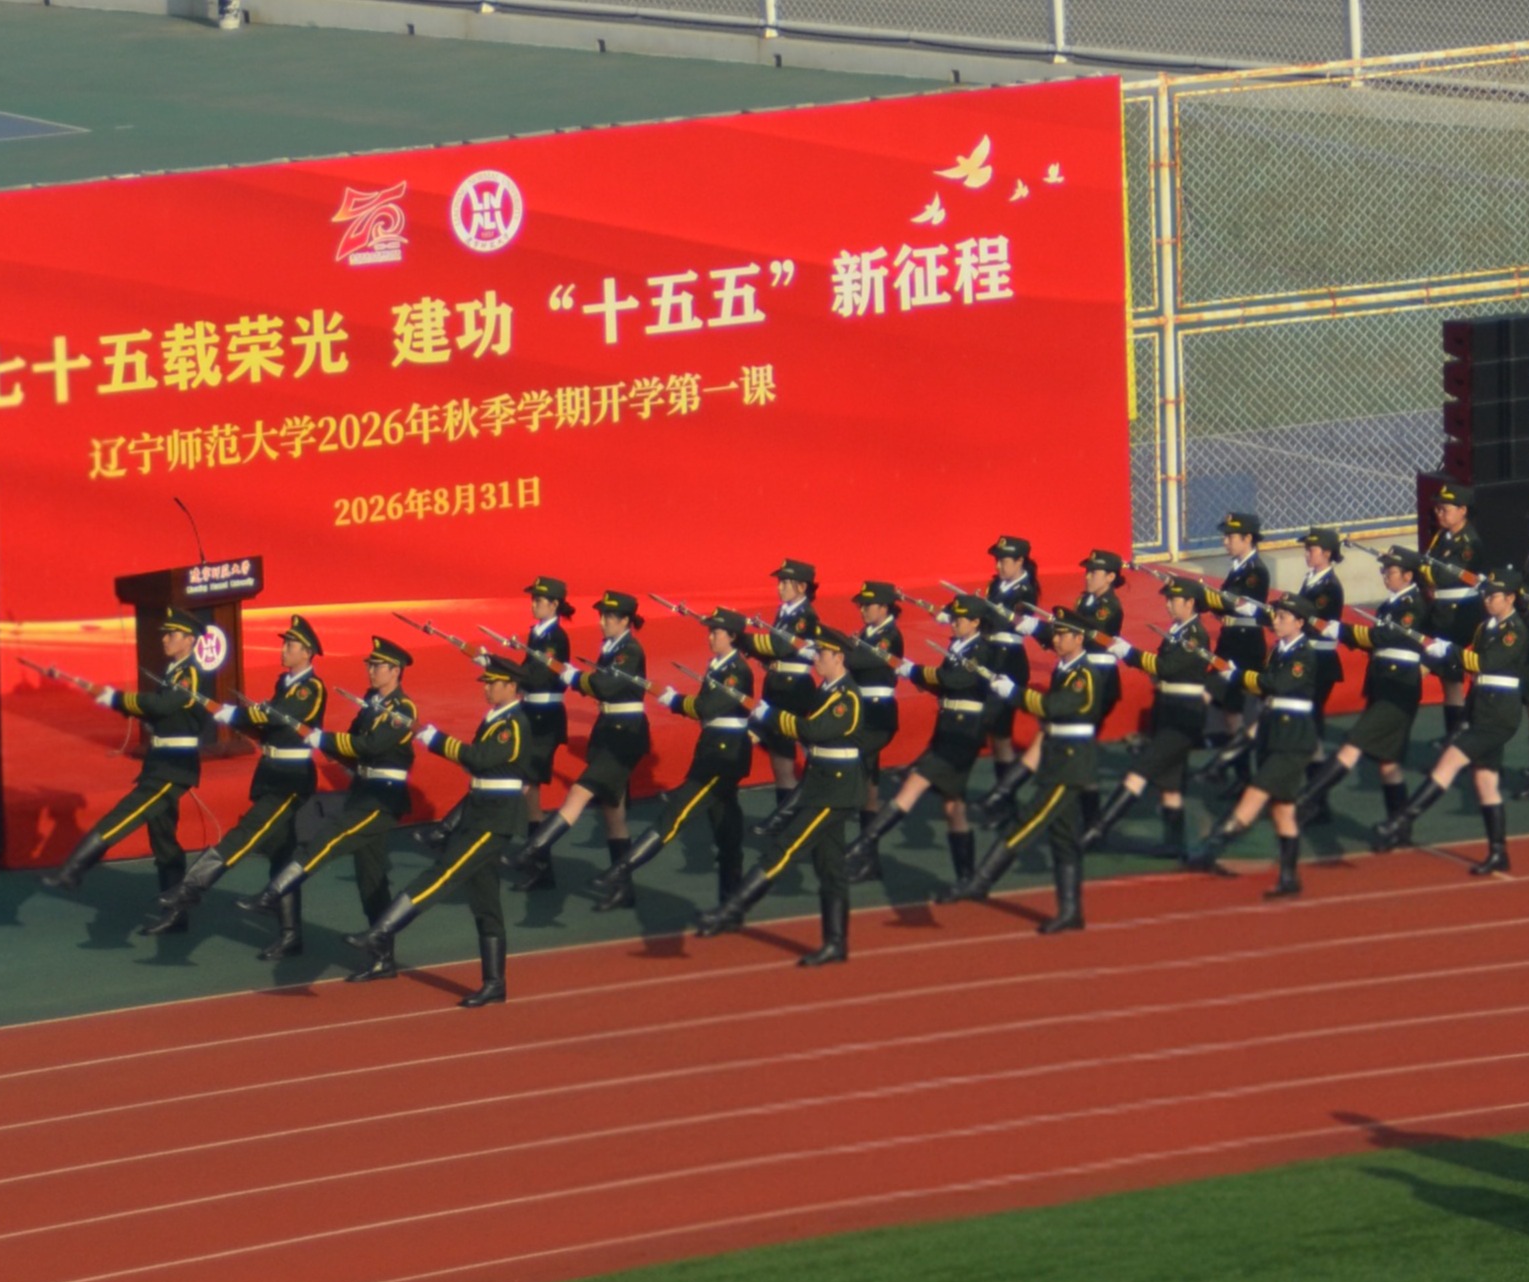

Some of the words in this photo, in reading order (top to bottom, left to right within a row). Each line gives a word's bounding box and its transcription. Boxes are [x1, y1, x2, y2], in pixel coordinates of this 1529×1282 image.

[88, 362, 777, 480] 辽宁师范大学2026年秋季学期开学第一课
[334, 476, 540, 527] 2026年8月31日
